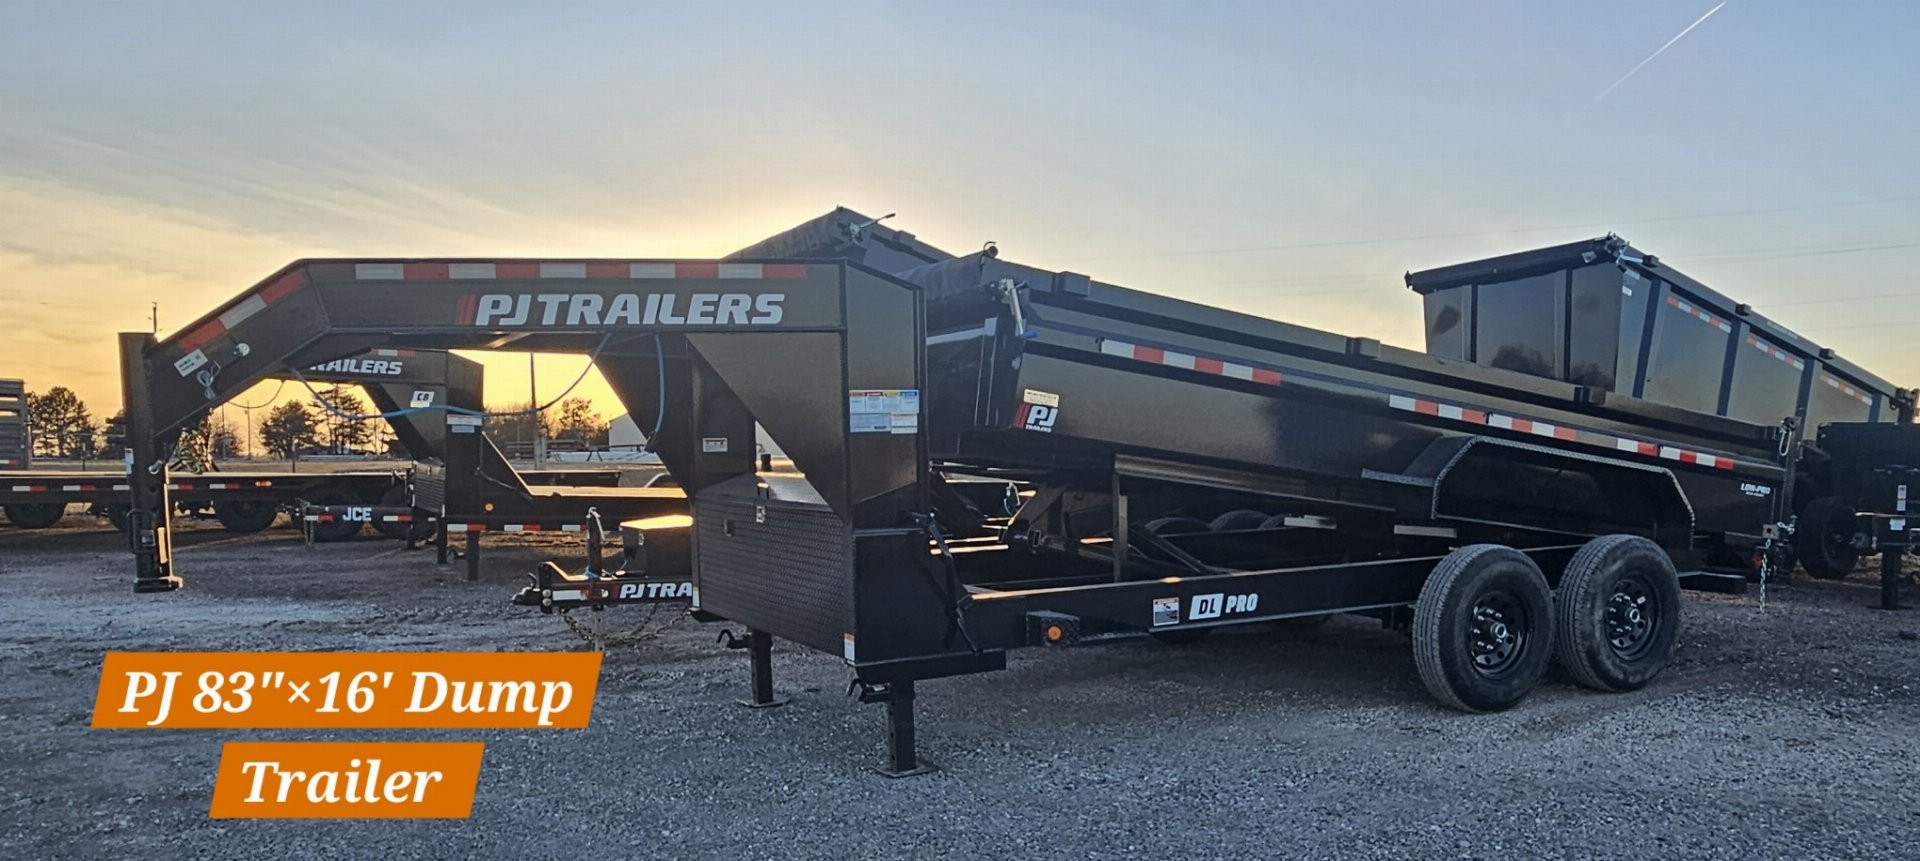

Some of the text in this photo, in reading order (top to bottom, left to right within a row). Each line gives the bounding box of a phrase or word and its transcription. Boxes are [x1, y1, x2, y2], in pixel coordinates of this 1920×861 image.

[475, 293, 785, 326] PJ TRAILERS
[1027, 405, 1059, 427] PJ
[342, 506, 372, 522] JCE
[619, 584, 645, 599] PJ
[1199, 593, 1258, 615] DL PRO
